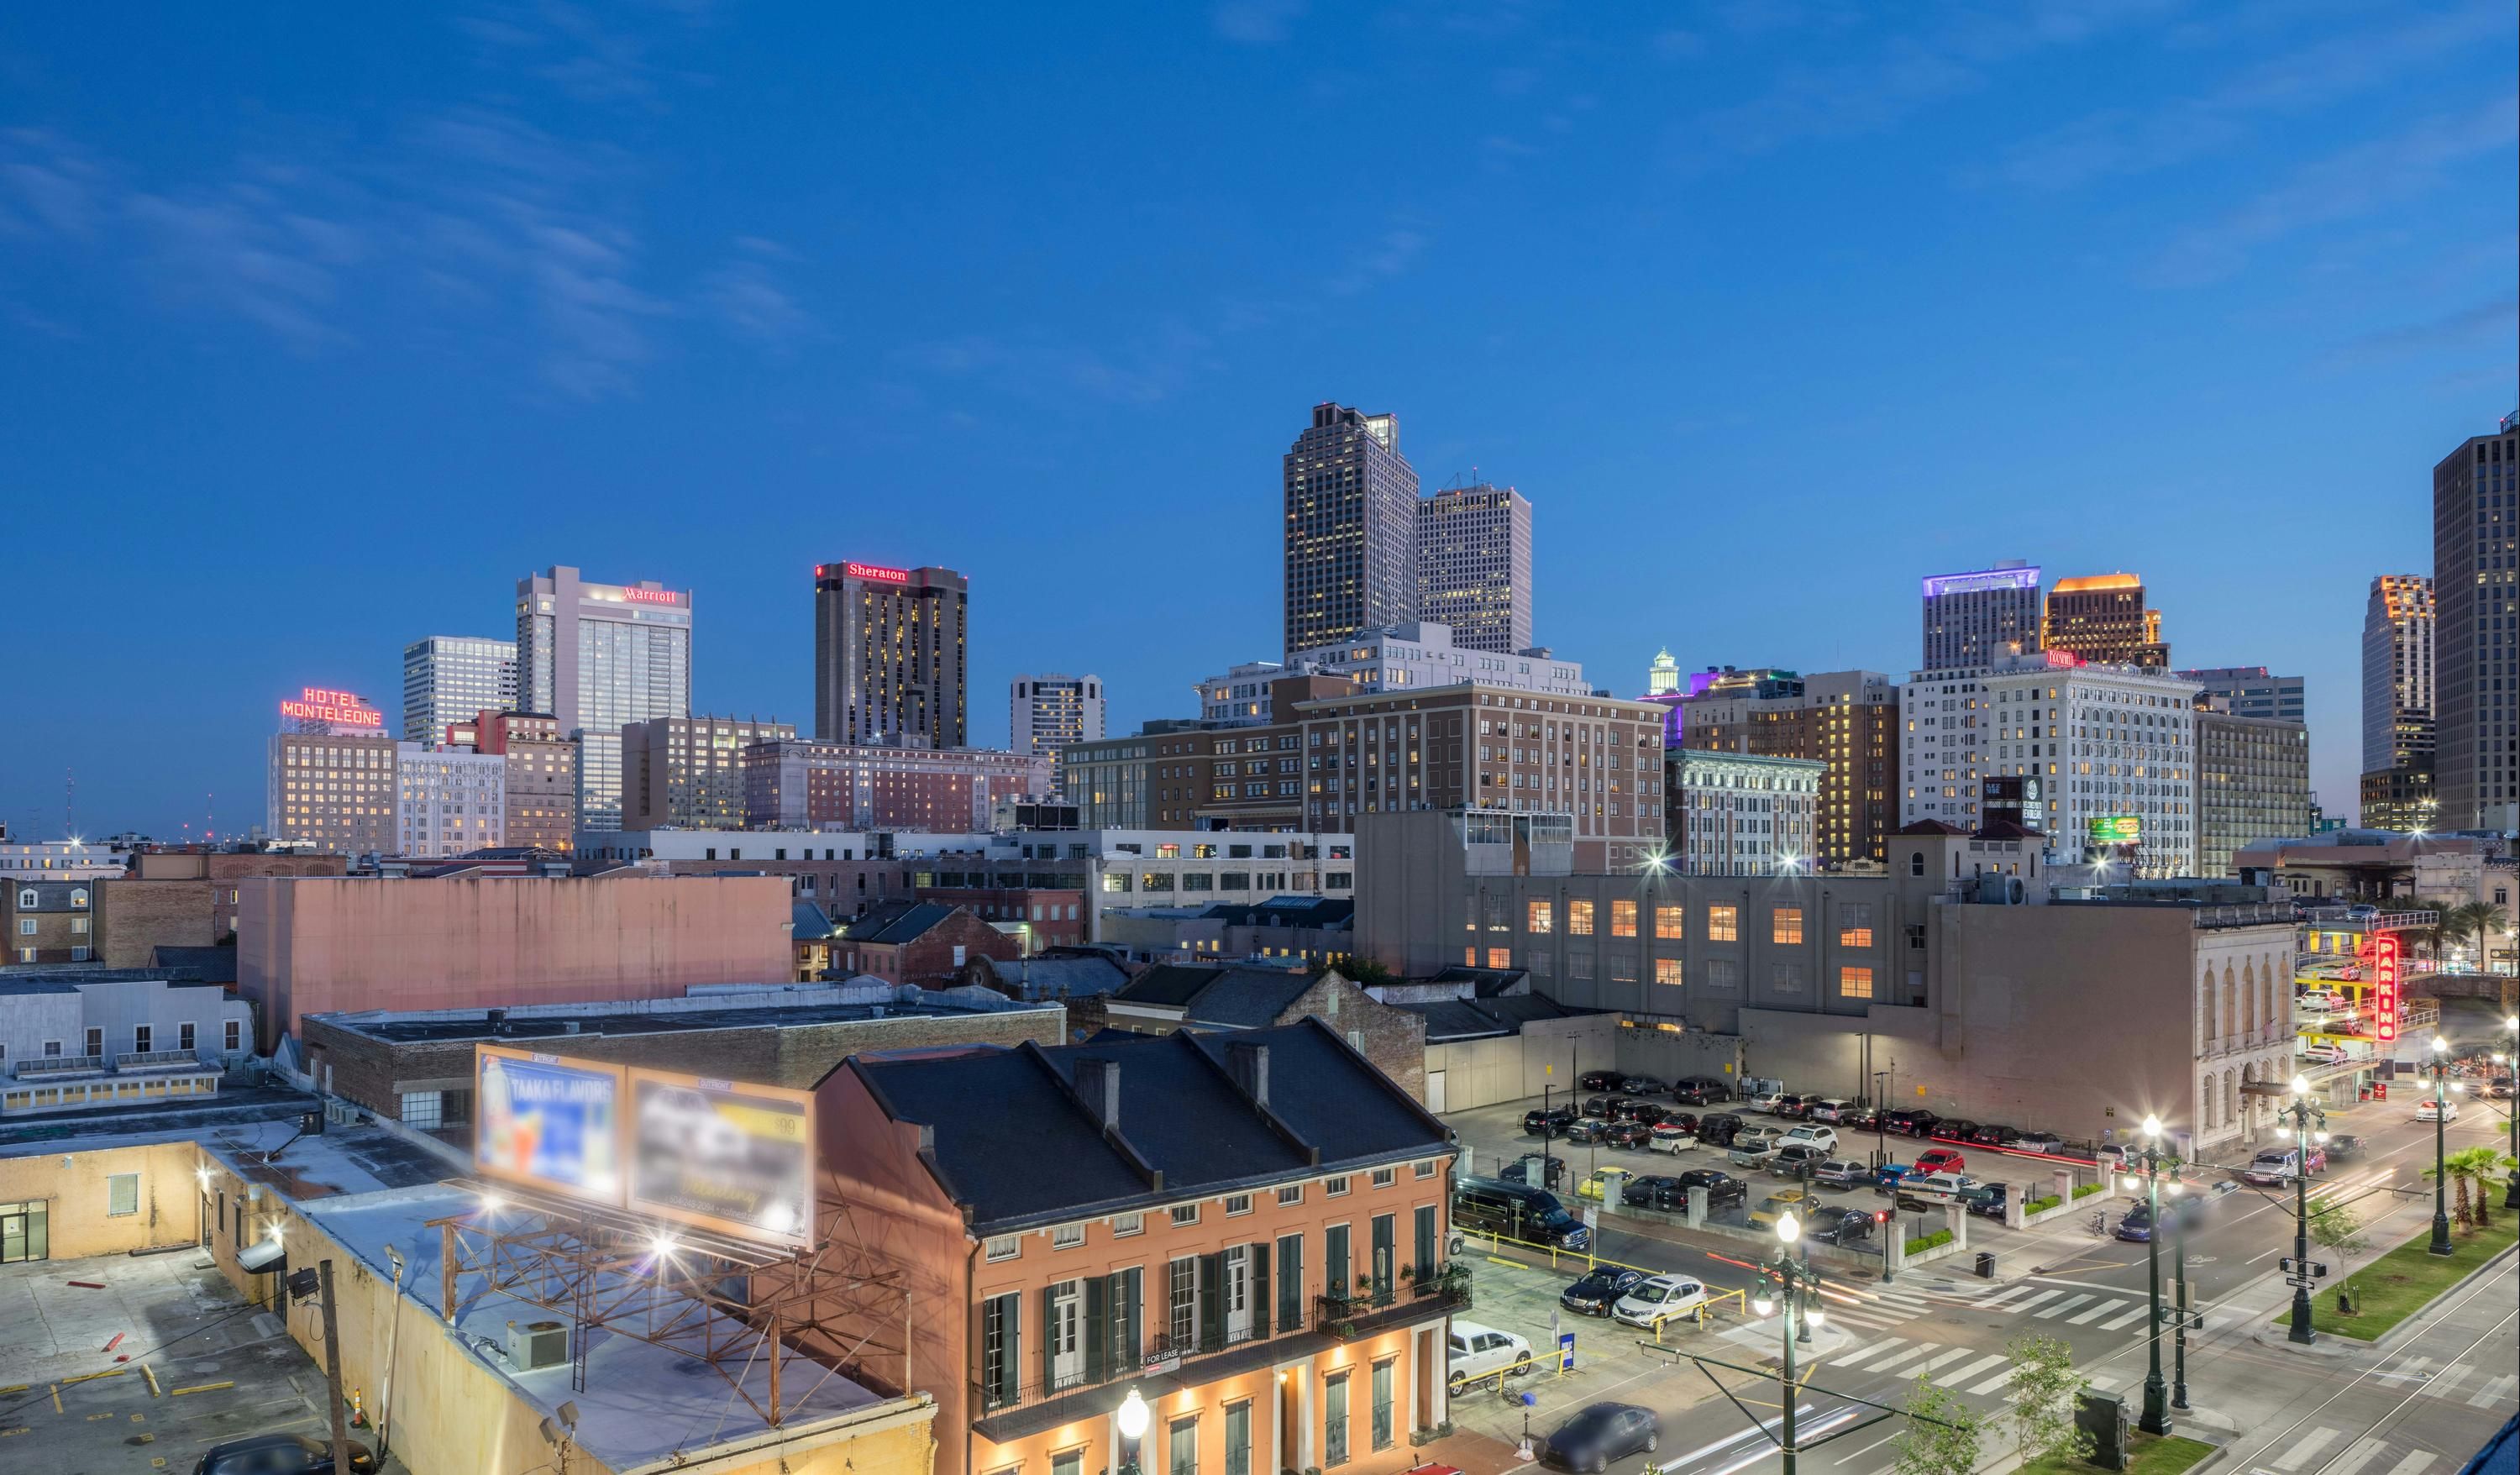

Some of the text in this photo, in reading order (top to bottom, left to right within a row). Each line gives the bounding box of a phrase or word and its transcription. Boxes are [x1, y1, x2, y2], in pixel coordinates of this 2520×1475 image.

[849, 564, 906, 580] Sheraton
[623, 587, 675, 602] Marriott
[304, 687, 360, 707] HOTEL
[282, 701, 381, 725] MONTELEONE
[2380, 943, 2393, 1037] PARKING
[512, 1079, 613, 1103] TAAKA FLAVORS
[1147, 1348, 1179, 1364] FOR LEASE
